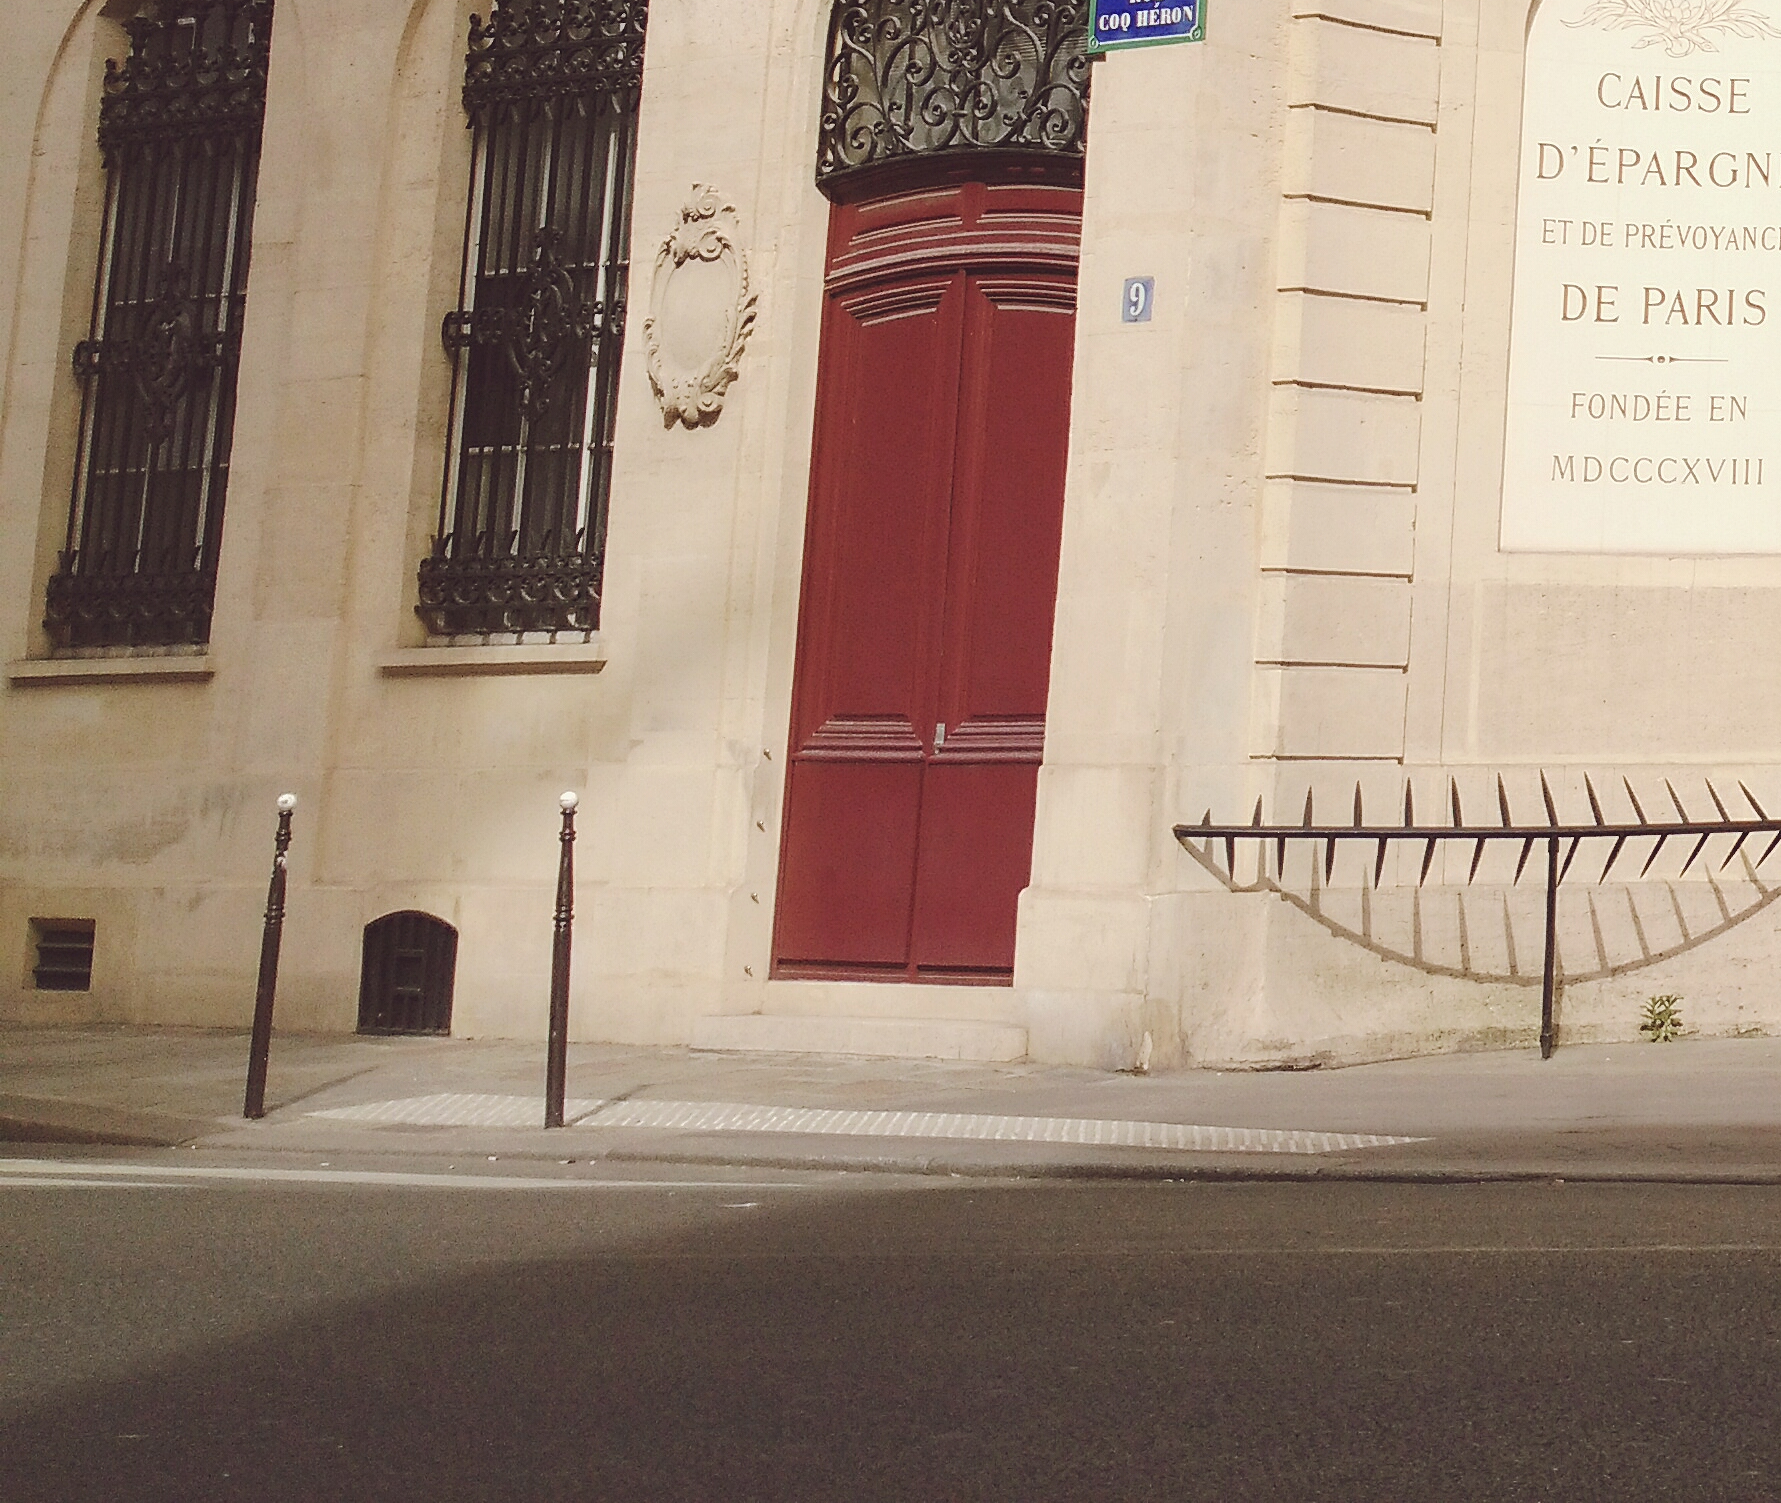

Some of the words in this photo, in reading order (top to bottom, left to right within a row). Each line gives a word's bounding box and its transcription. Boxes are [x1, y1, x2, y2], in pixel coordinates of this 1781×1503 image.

[1099, 13, 1131, 32] COQ
[1137, 2, 1193, 28] HÉRON
[1596, 72, 1752, 115] CAISSE
[1541, 218, 1573, 247] ET
[1580, 220, 1614, 248] DE
[1129, 282, 1145, 316] 9
[1560, 283, 1620, 323] DE
[1642, 287, 1768, 327] PARIS
[1569, 390, 1692, 423] FONDÉE
[1709, 395, 1749, 423] EN
[1550, 454, 1766, 486] MDCCCXVIII
